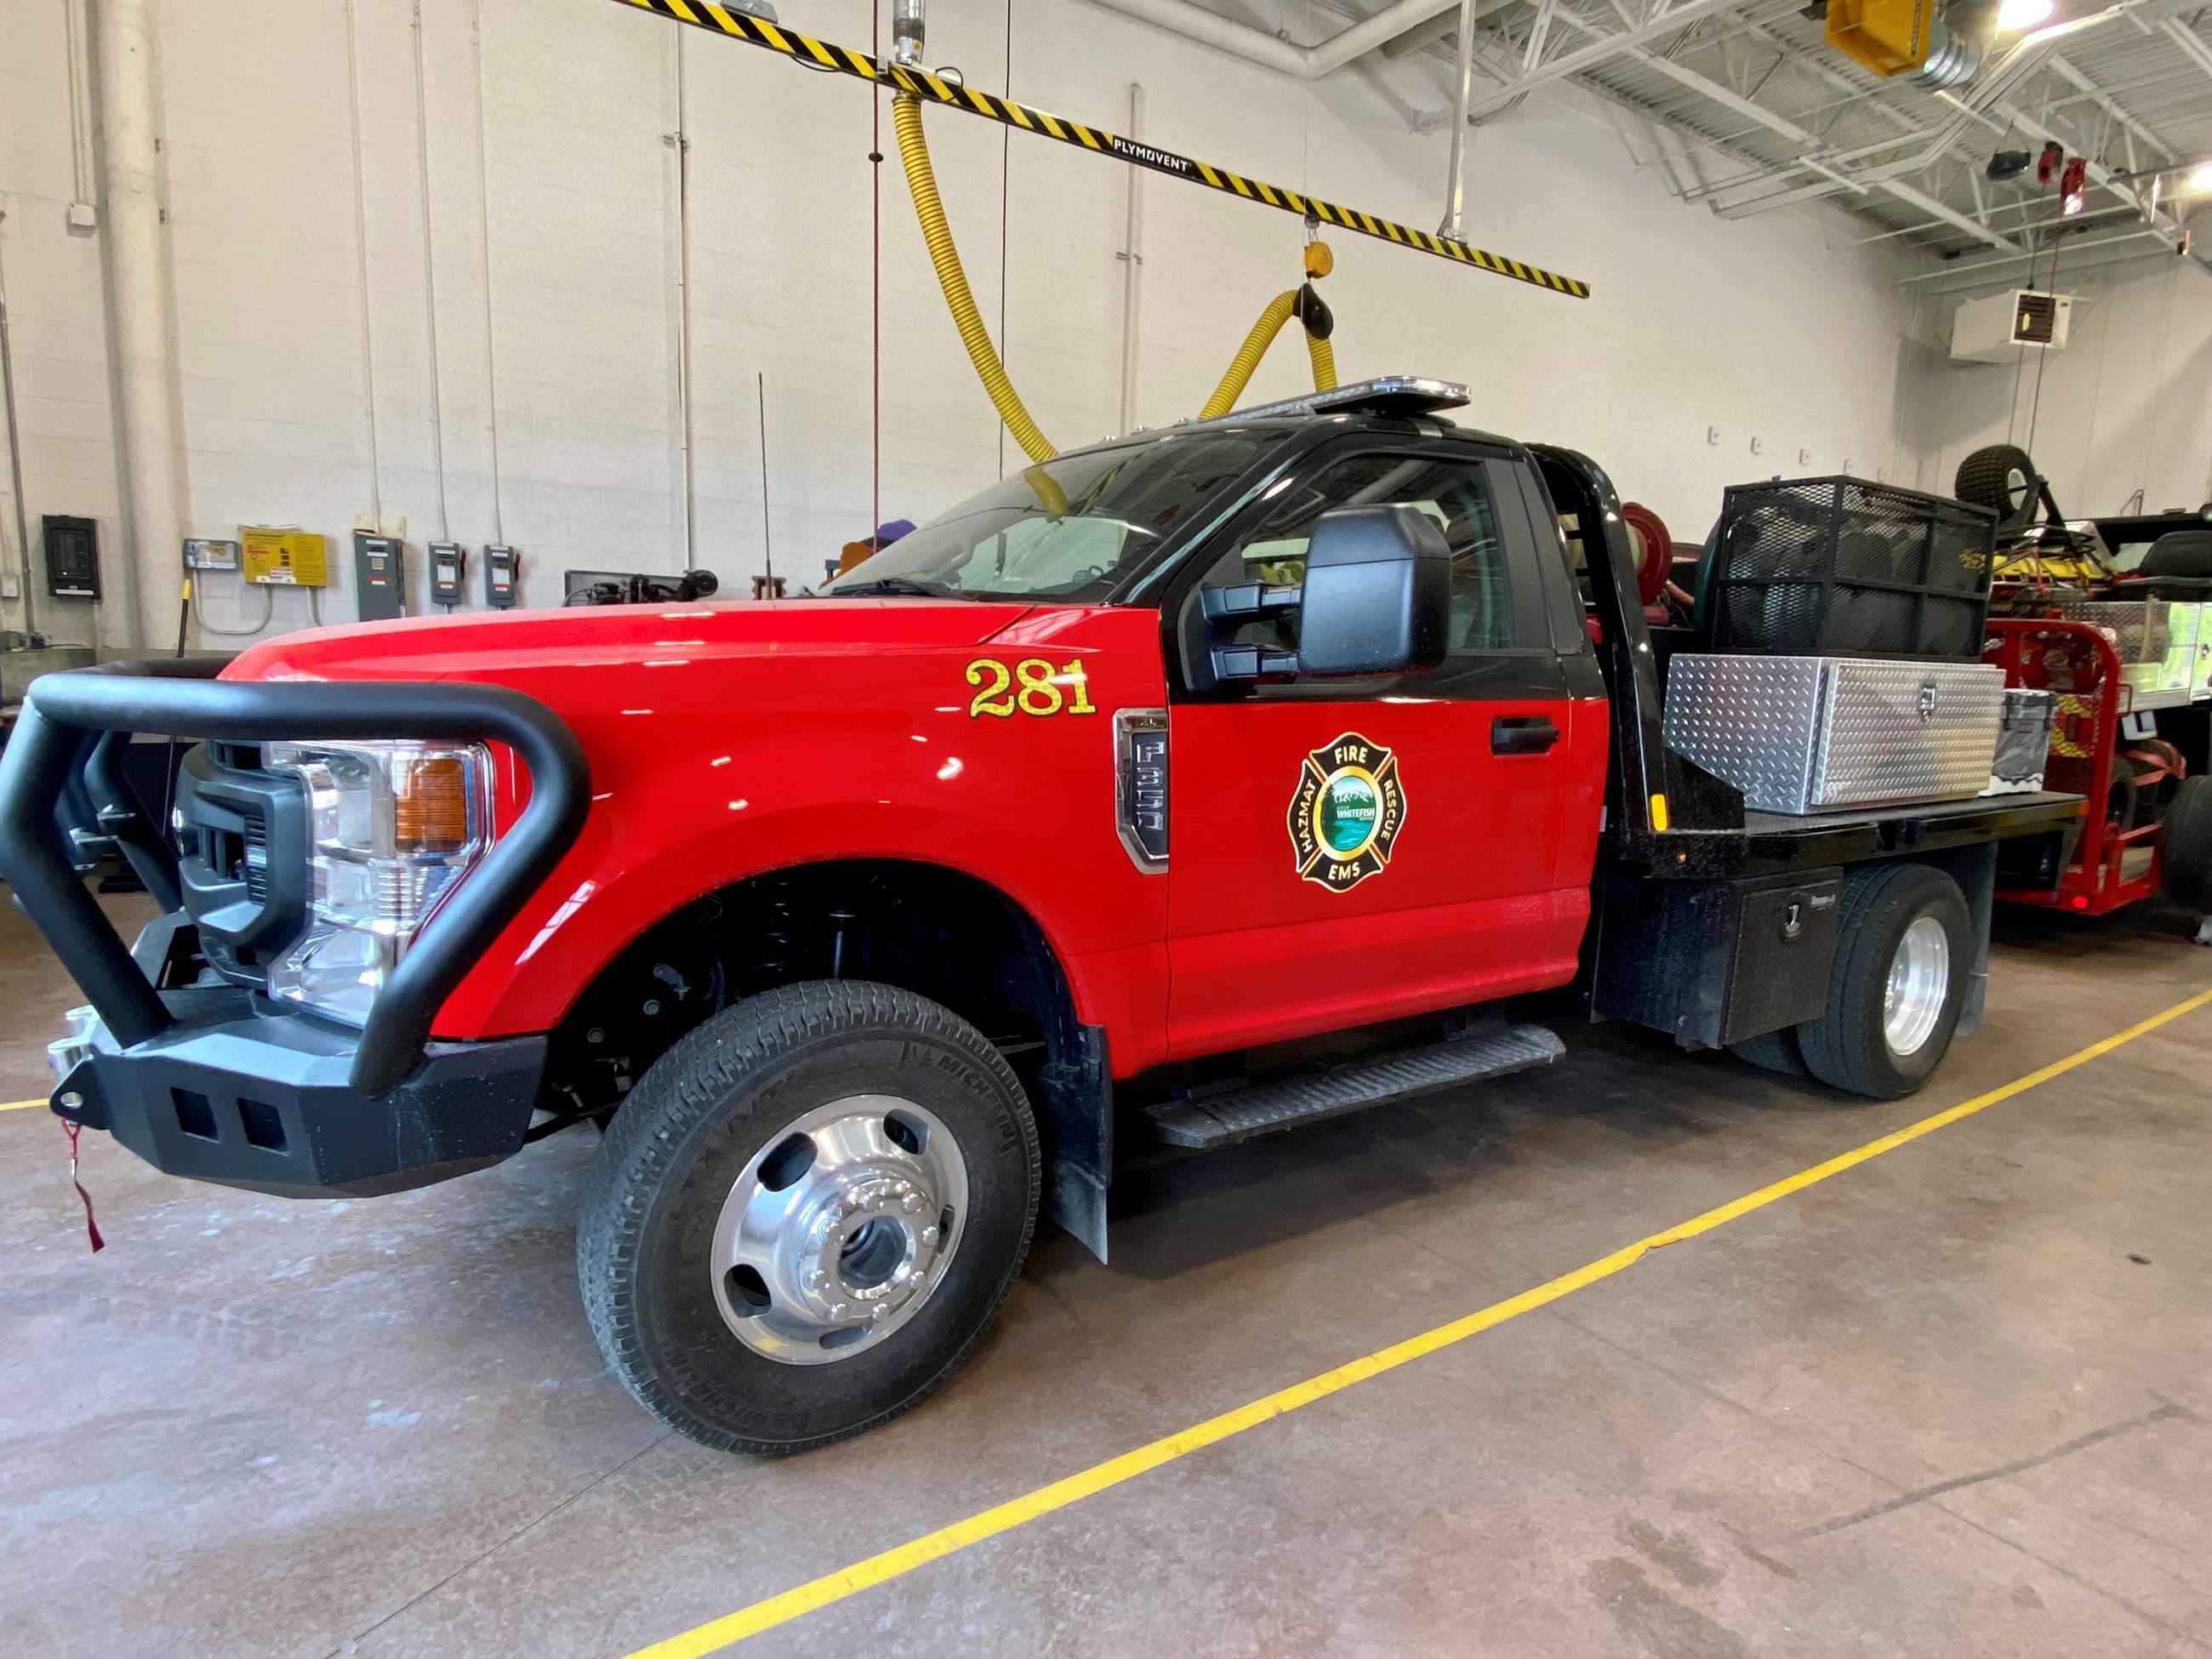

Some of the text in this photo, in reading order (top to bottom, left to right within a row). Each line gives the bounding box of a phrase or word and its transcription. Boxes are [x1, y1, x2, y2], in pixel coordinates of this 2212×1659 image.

[966, 658, 1097, 718] 281
[1334, 745, 1368, 765] FIRE
[1297, 778, 1316, 852] HAZMAT
[1337, 807, 1375, 819] WHITEFISH
[1381, 779, 1397, 841] RESCUE
[1327, 861, 1361, 881] EMS
